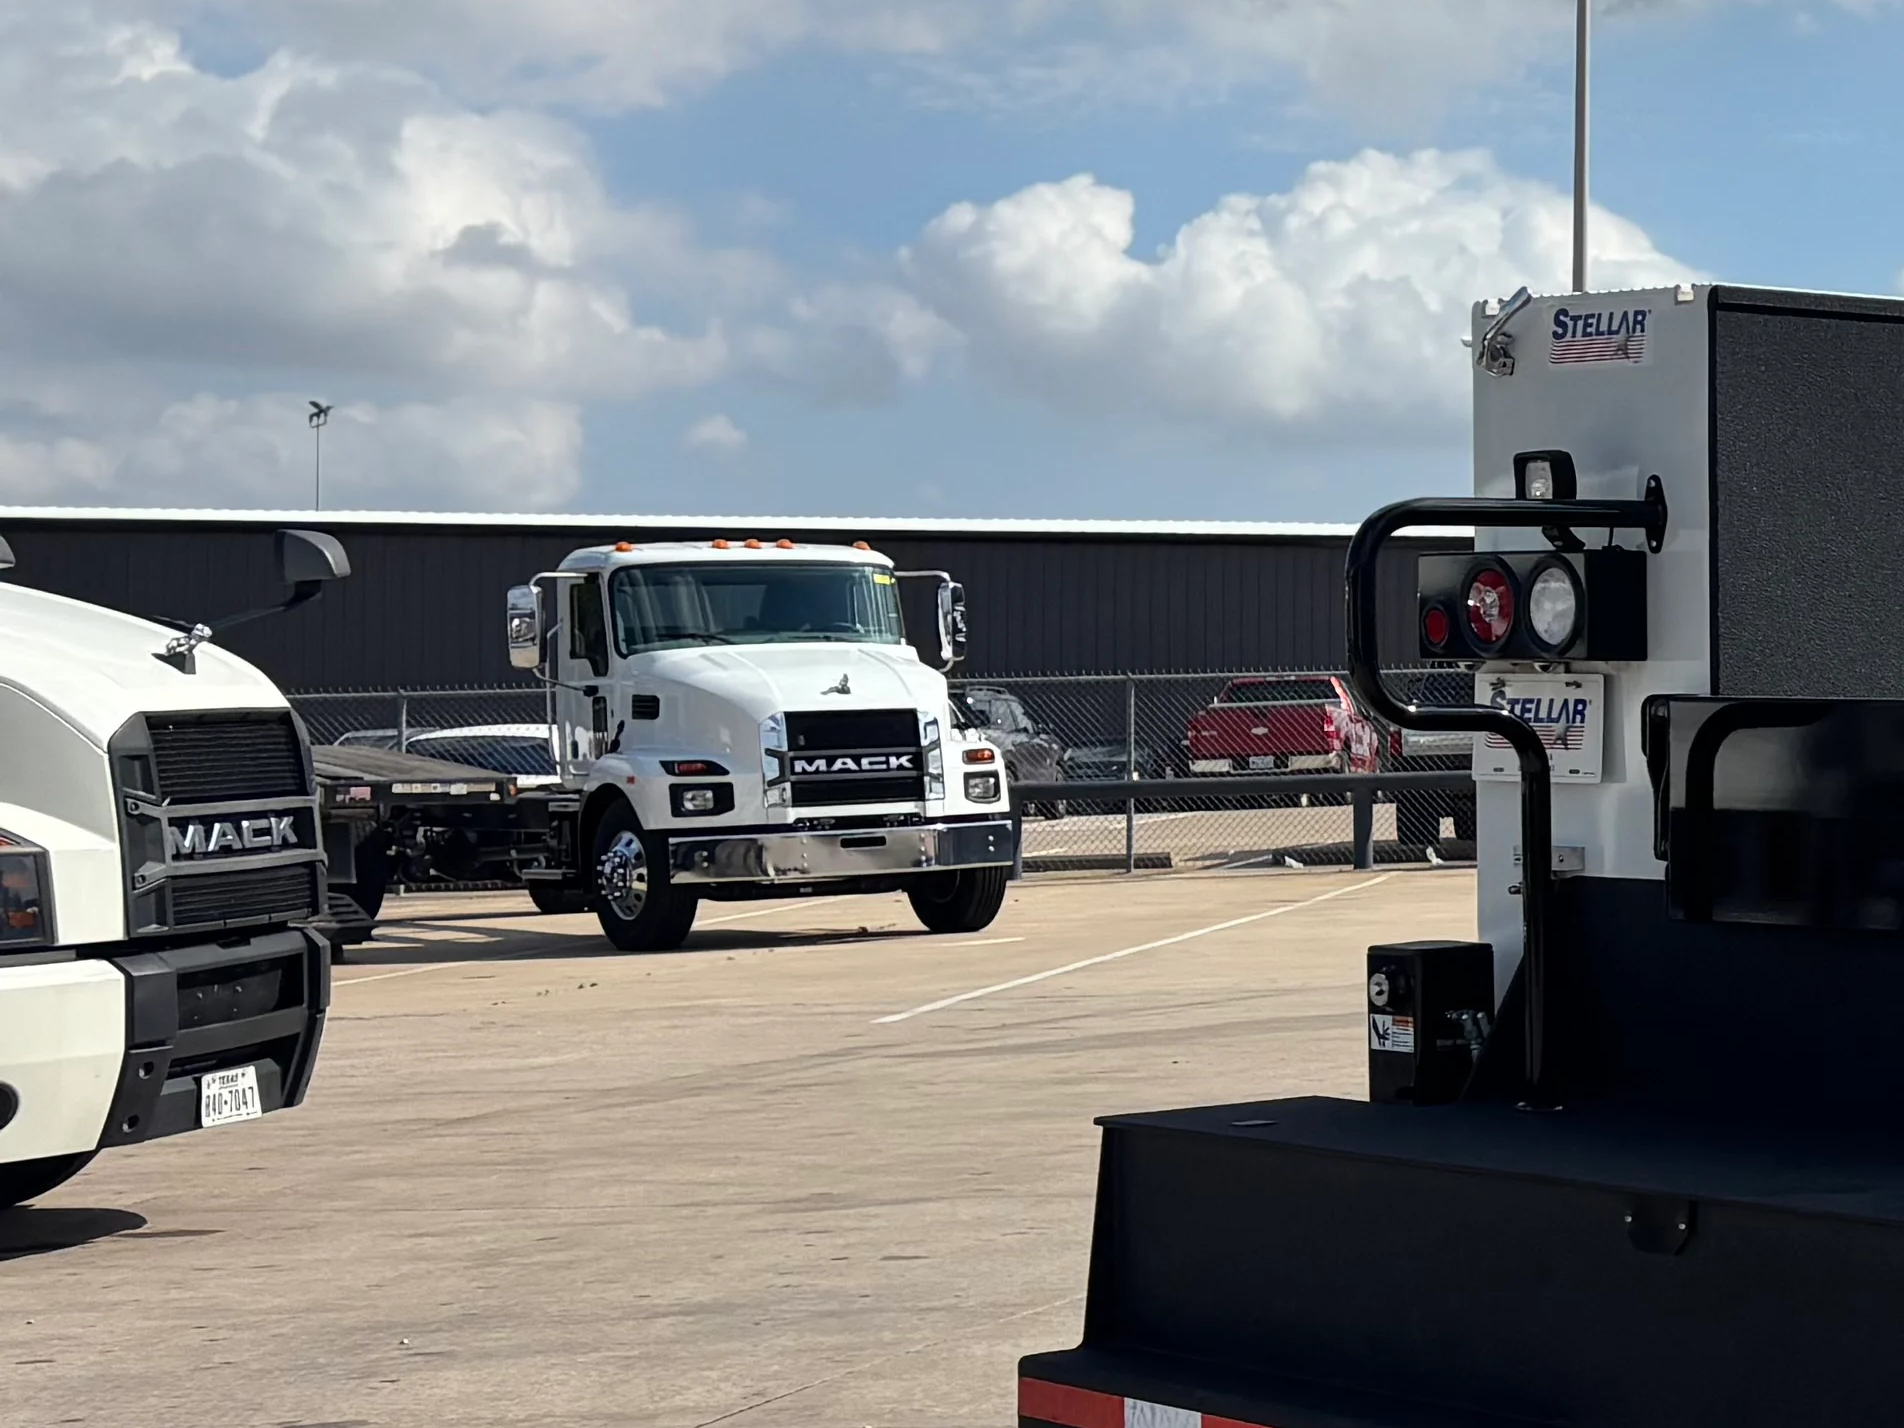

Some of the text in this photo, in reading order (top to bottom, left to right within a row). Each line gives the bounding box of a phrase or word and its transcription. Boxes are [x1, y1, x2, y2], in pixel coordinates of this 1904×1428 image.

[1552, 308, 1648, 341] STELLAR
[1490, 689, 1588, 725] STELLAR
[793, 754, 914, 773] MACK
[168, 815, 299, 856] MACK
[219, 1072, 239, 1085] TEXAS
